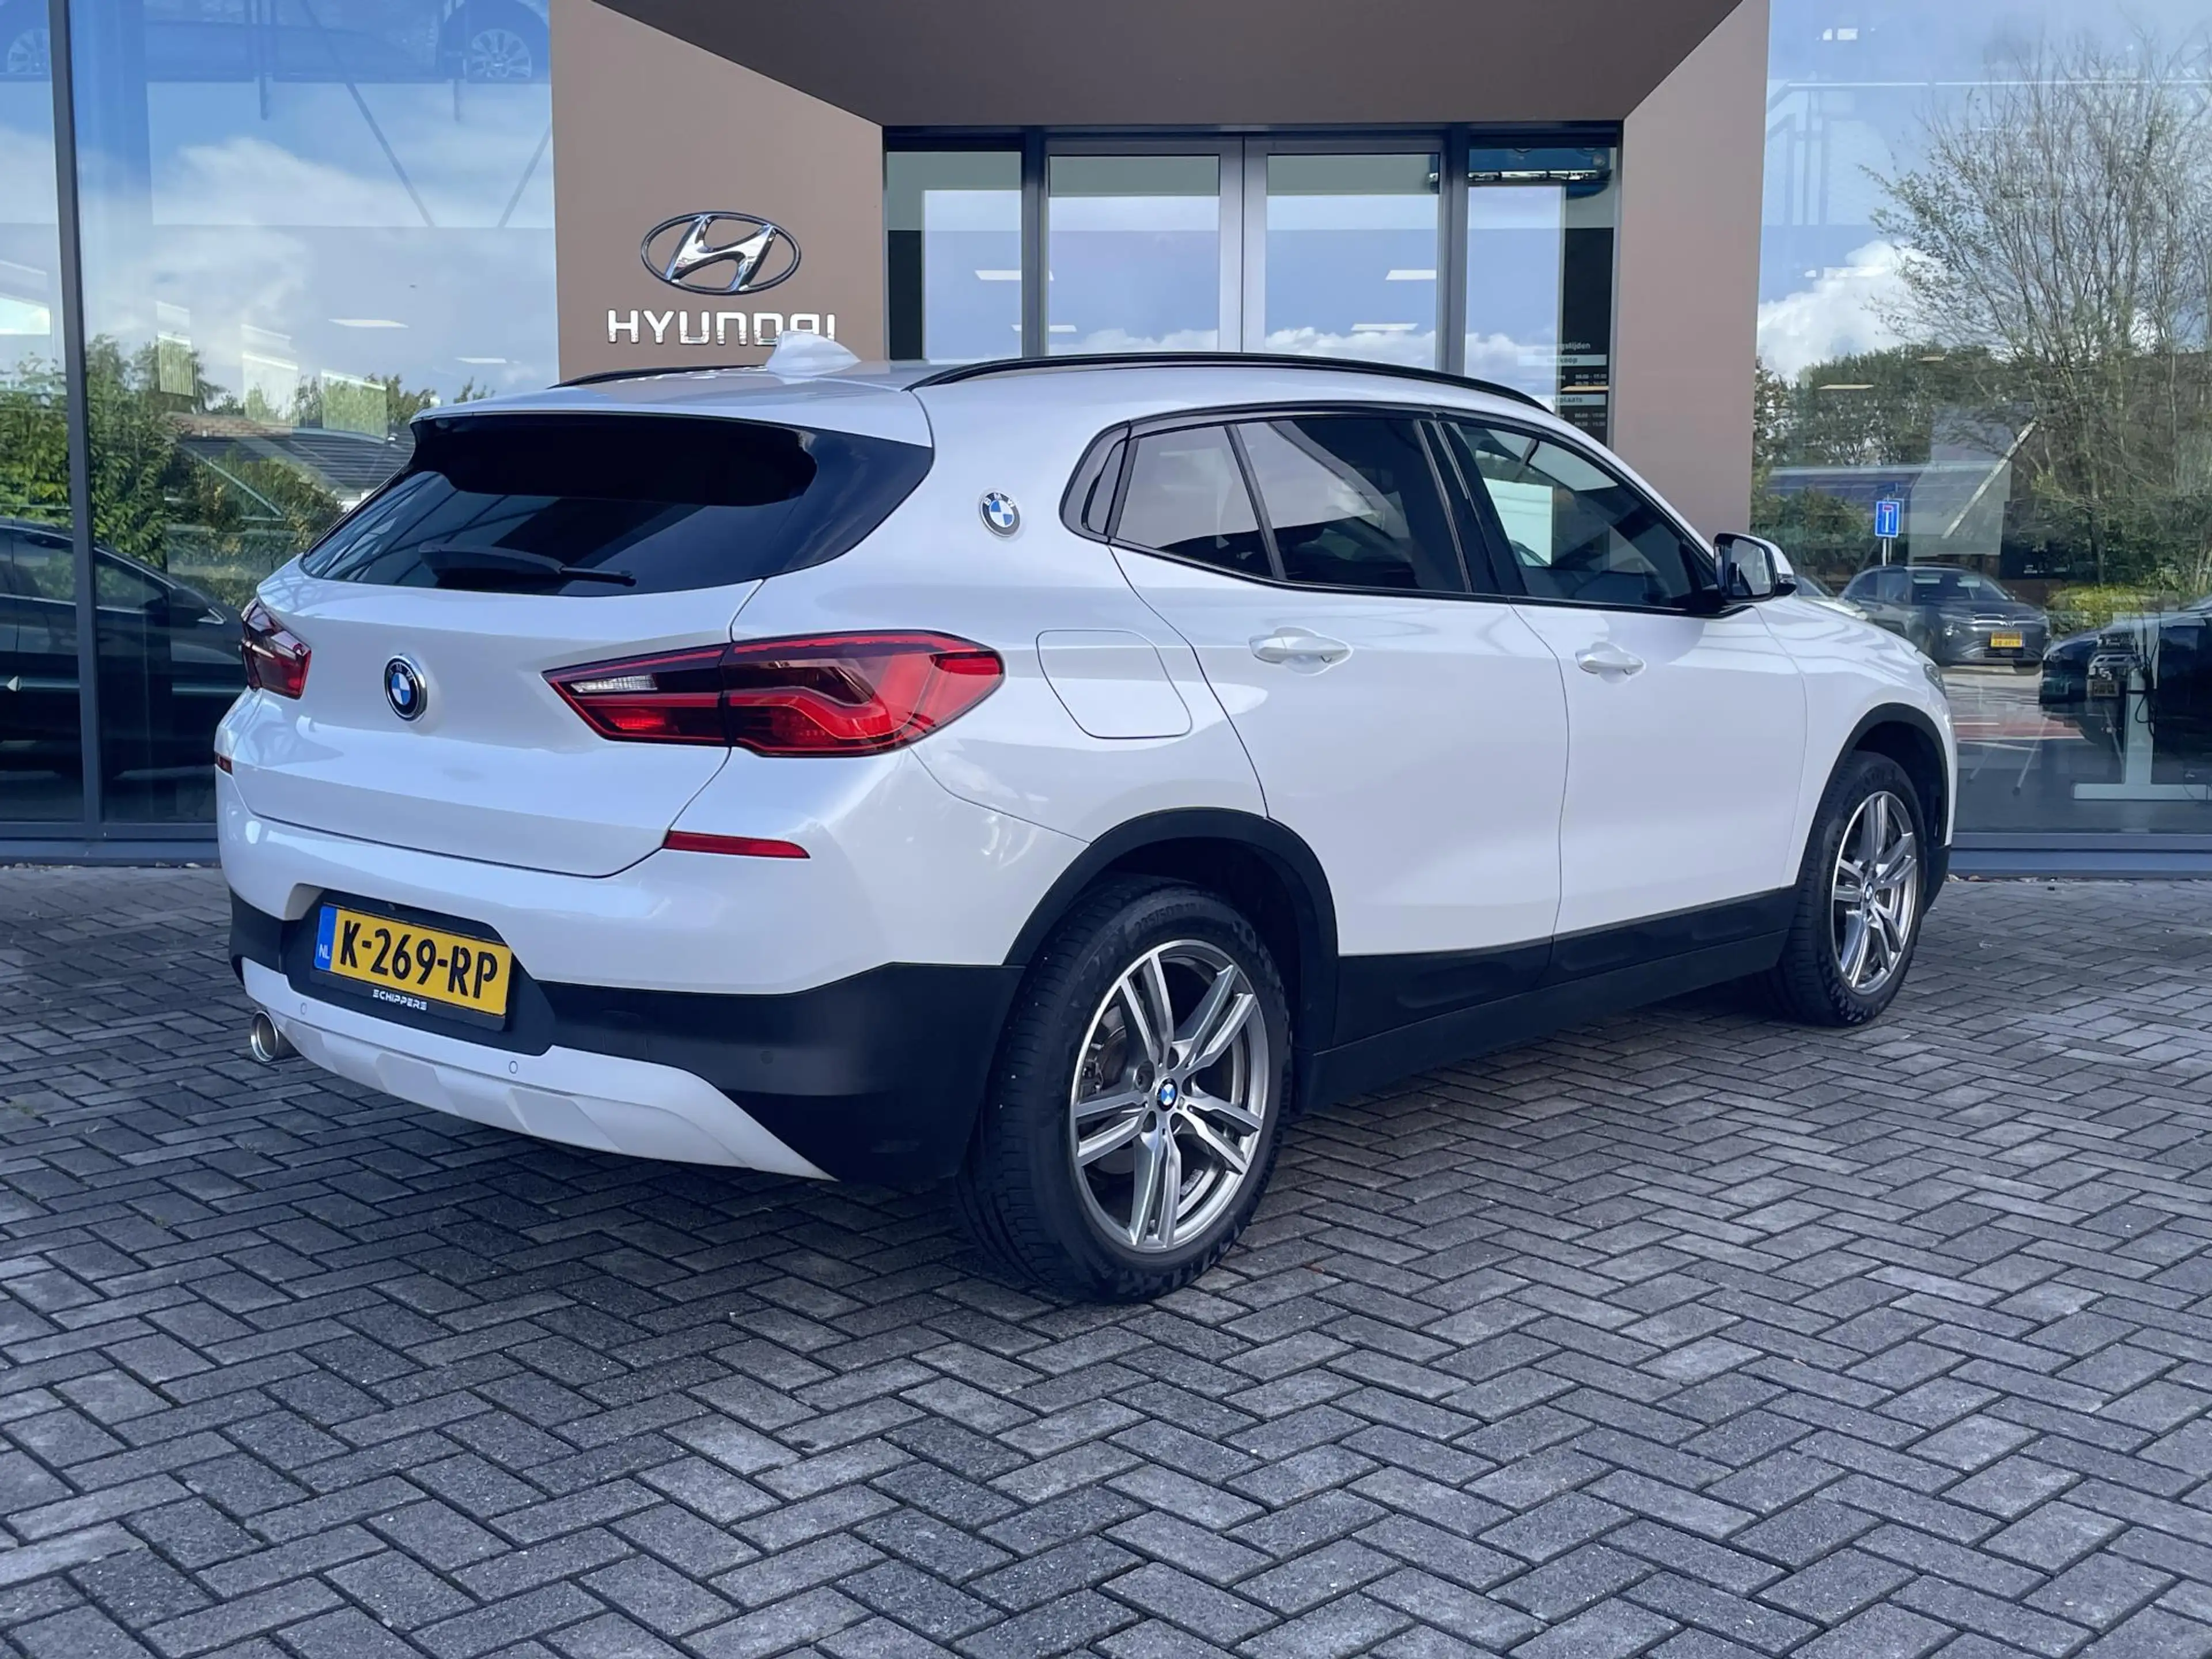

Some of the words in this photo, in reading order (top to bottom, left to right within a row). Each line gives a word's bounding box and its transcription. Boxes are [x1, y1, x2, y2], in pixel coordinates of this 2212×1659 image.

[607, 309, 836, 346] HYUNDAI
[319, 944, 330, 960] NL
[339, 920, 498, 999] K-269-RP
